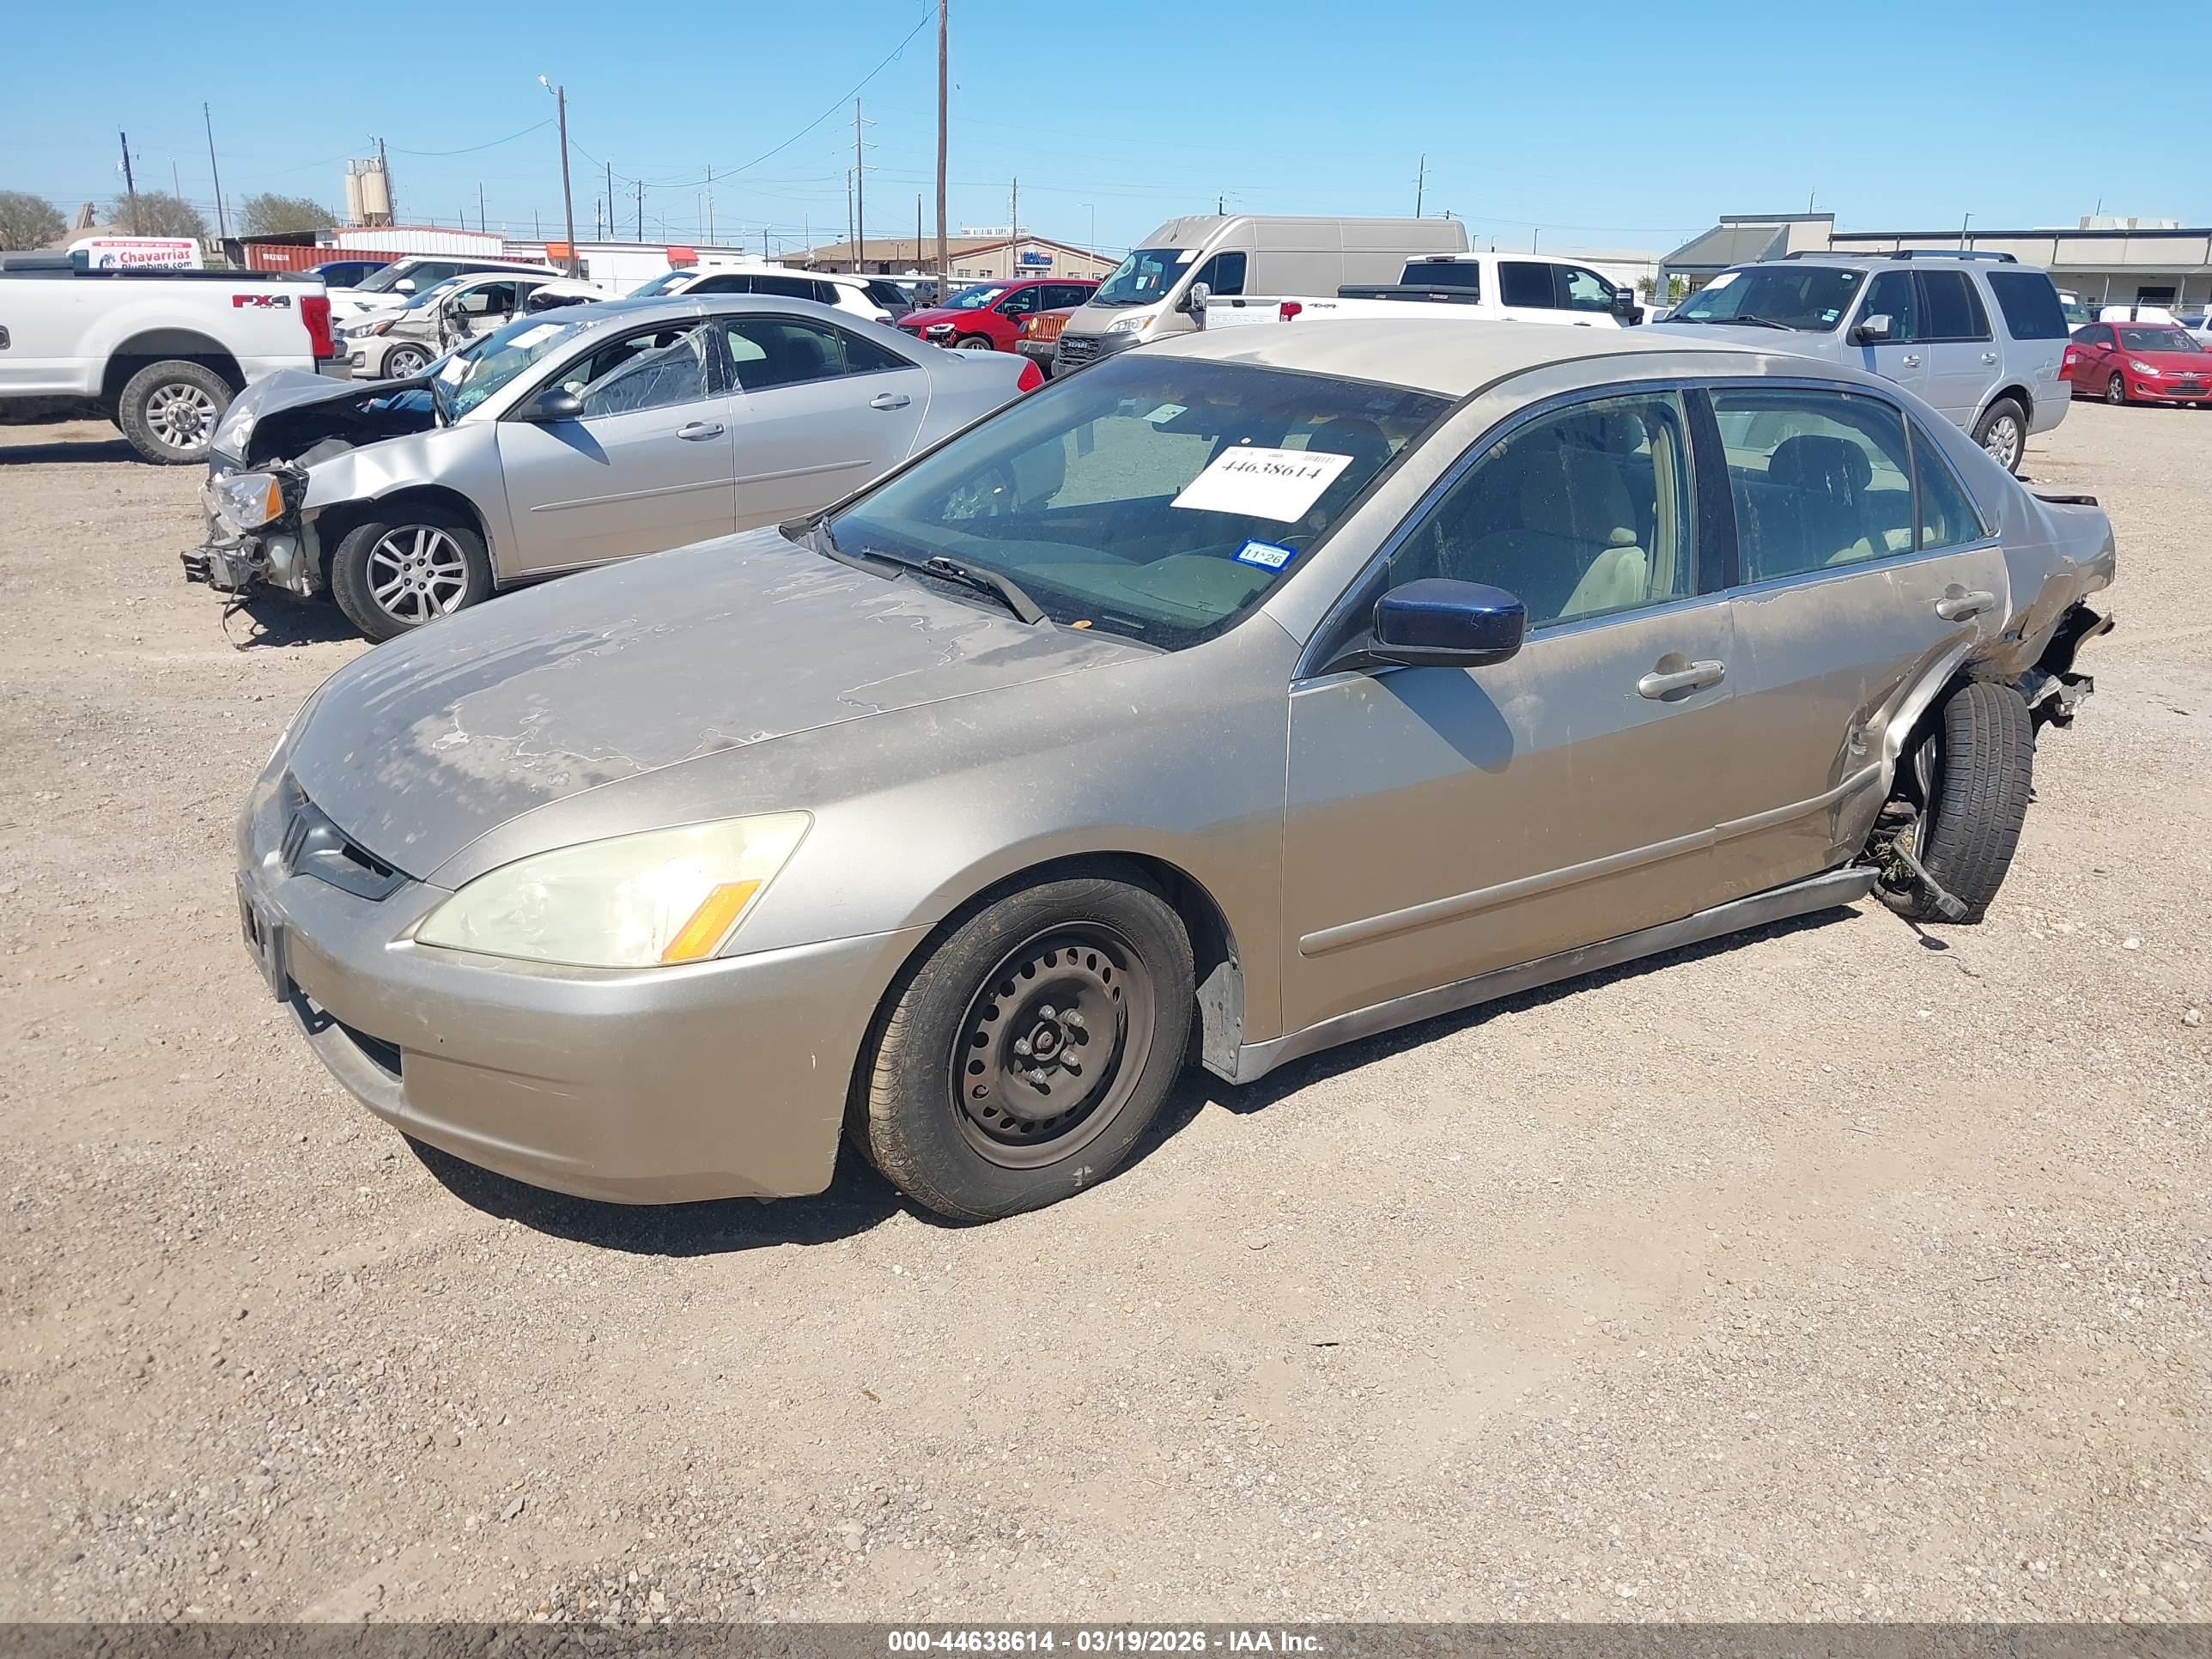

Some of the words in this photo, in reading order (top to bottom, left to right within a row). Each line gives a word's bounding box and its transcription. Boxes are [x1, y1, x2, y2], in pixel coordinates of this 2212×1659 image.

[120, 249, 191, 264] Chavarrias
[233, 295, 291, 308] FX4
[1223, 460, 1322, 479] 44638614
